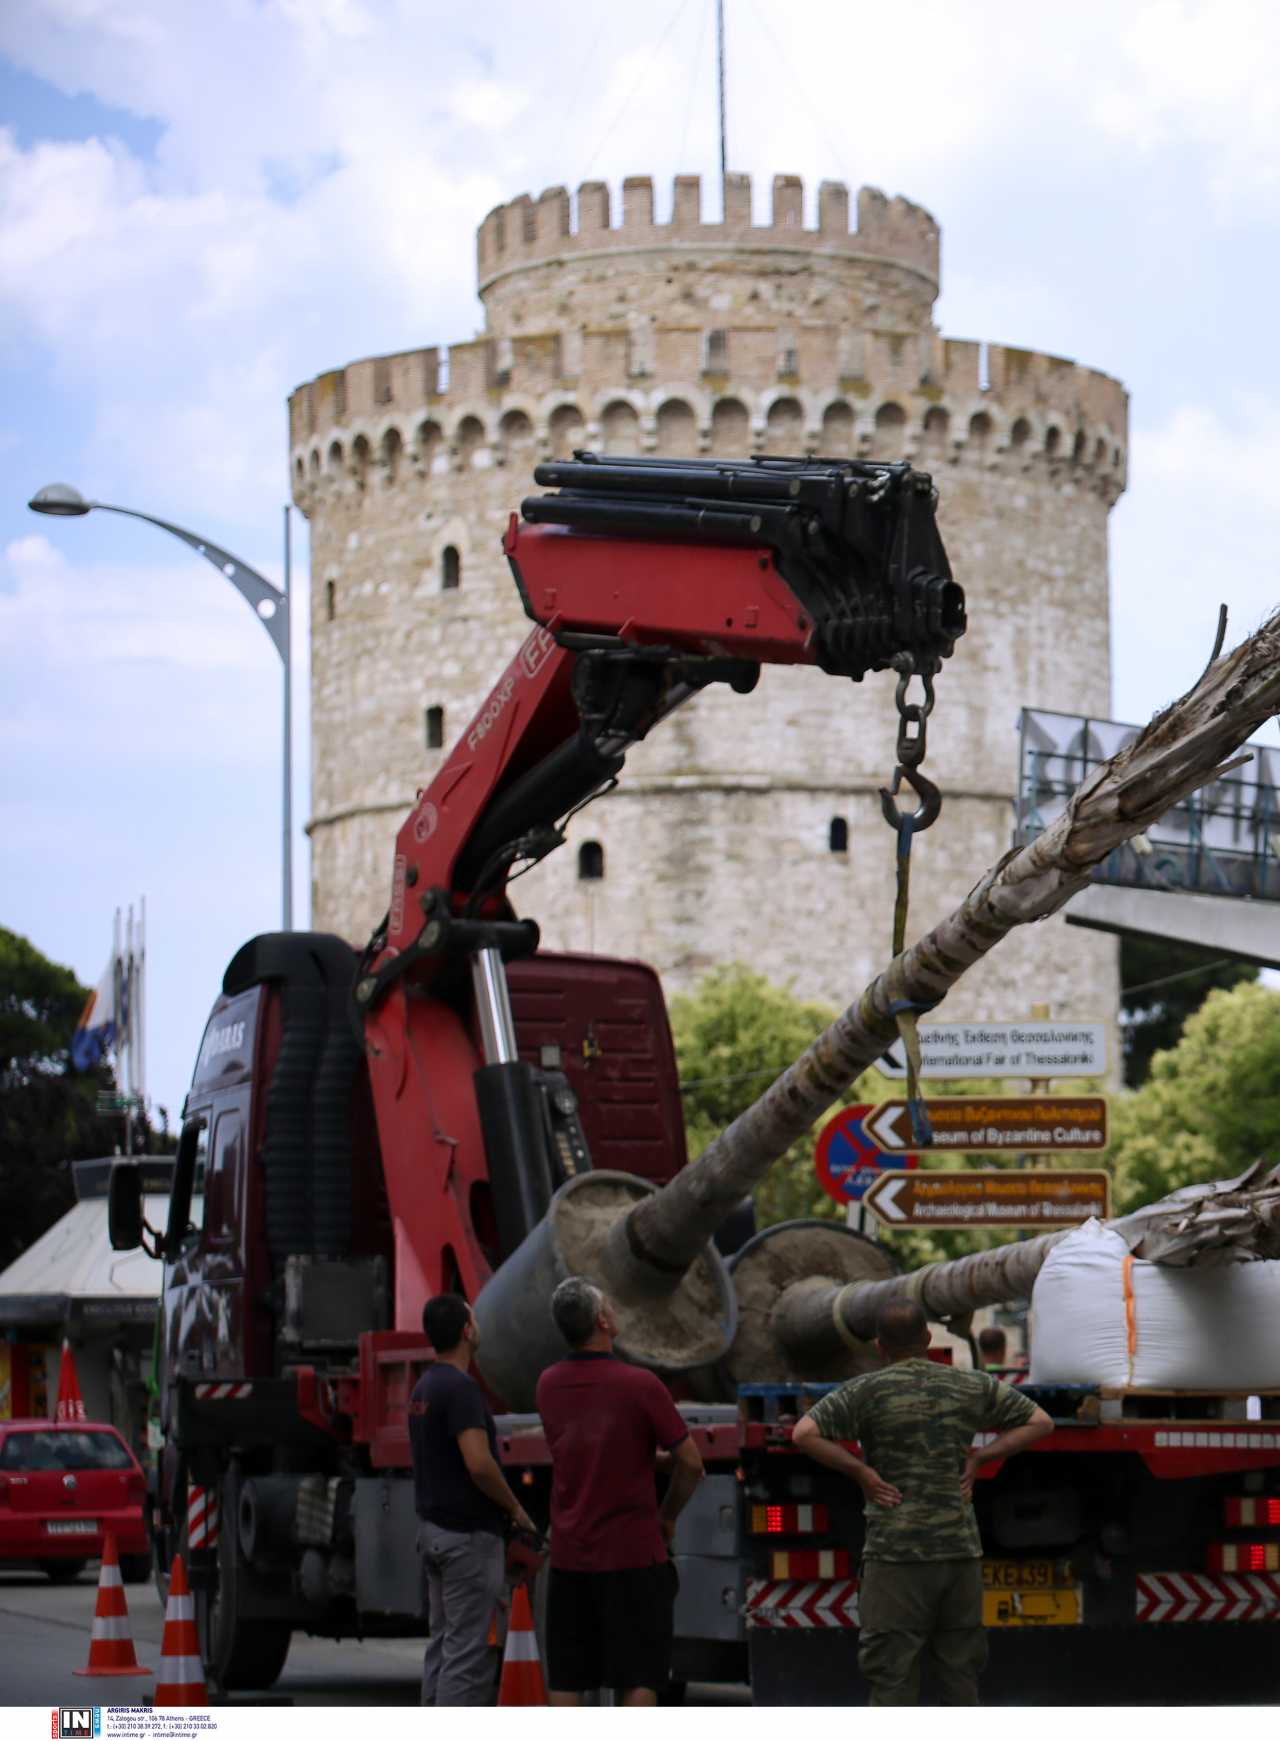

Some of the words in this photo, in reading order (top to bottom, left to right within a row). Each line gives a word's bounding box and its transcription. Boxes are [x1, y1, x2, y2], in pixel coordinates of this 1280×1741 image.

[920, 1052, 983, 1066] nternational
[985, 1051, 1005, 1066] Fair
[1009, 1051, 1021, 1066] of
[1024, 1051, 1094, 1065] Thessaloniki
[924, 1129, 968, 1145] seum
[970, 1128, 984, 1145] of
[987, 1127, 1050, 1146] Byzantine
[1053, 1126, 1102, 1143] Culture
